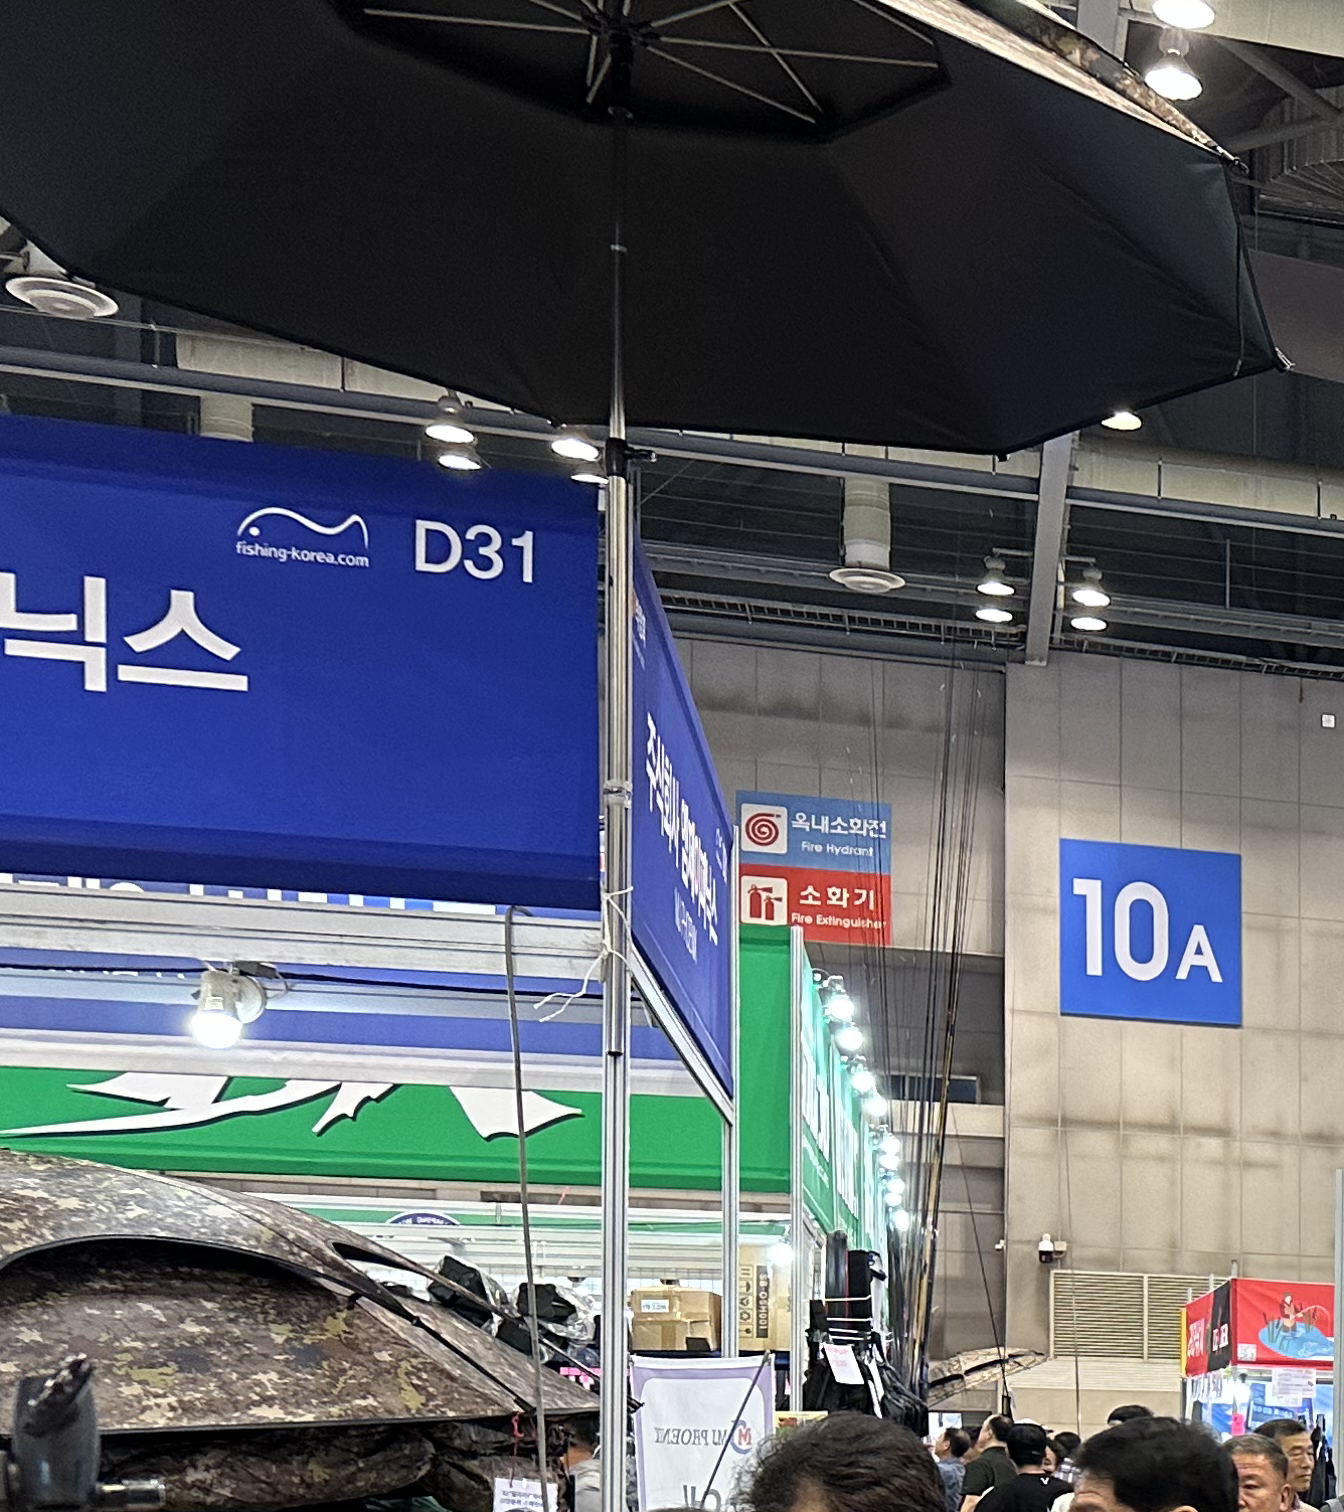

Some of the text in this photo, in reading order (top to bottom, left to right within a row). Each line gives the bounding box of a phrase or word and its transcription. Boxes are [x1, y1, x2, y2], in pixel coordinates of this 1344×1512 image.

[236, 540, 370, 569] fishing-korea.com
[415, 519, 535, 584] D31
[791, 811, 888, 840] 옥내소화전
[801, 840, 875, 859] Fire Hydrant
[799, 884, 877, 911] 소화기
[791, 911, 813, 925] Fire
